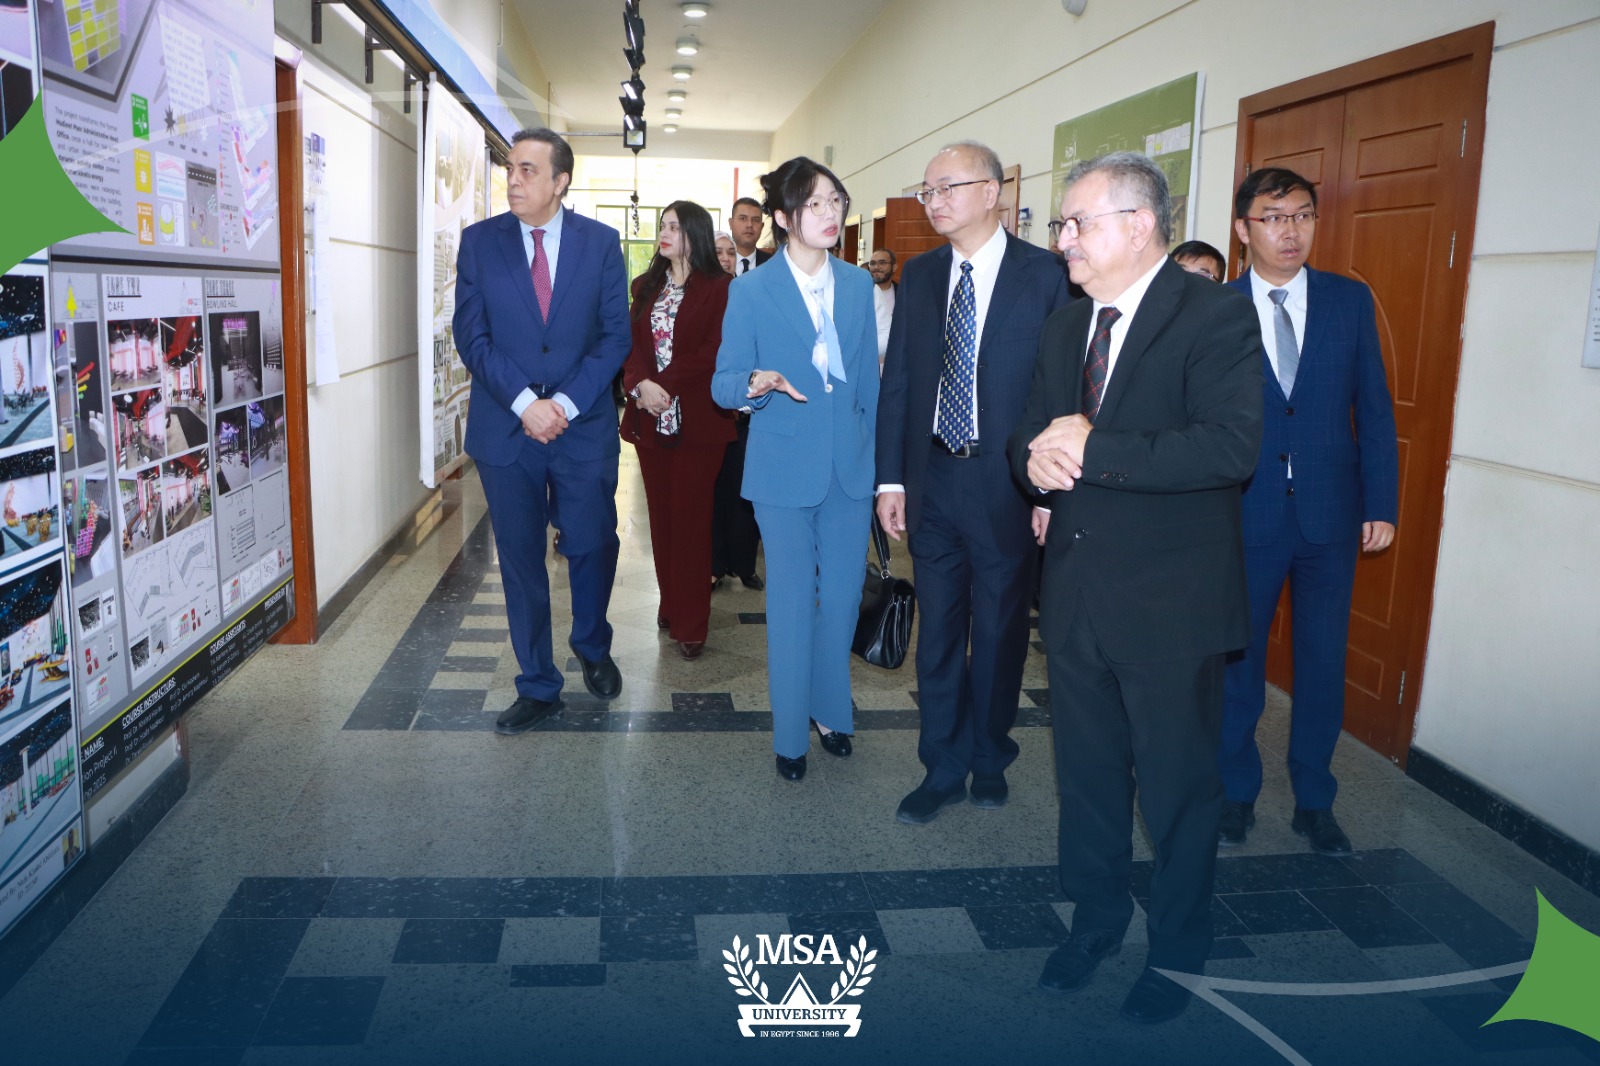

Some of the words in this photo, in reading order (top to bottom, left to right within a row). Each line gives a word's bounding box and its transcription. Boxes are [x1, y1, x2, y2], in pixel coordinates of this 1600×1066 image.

[107, 301, 124, 312] CAFE
[122, 702, 143, 728] COURSE
[84, 736, 104, 759] NAME:
[94, 750, 113, 773] Project
